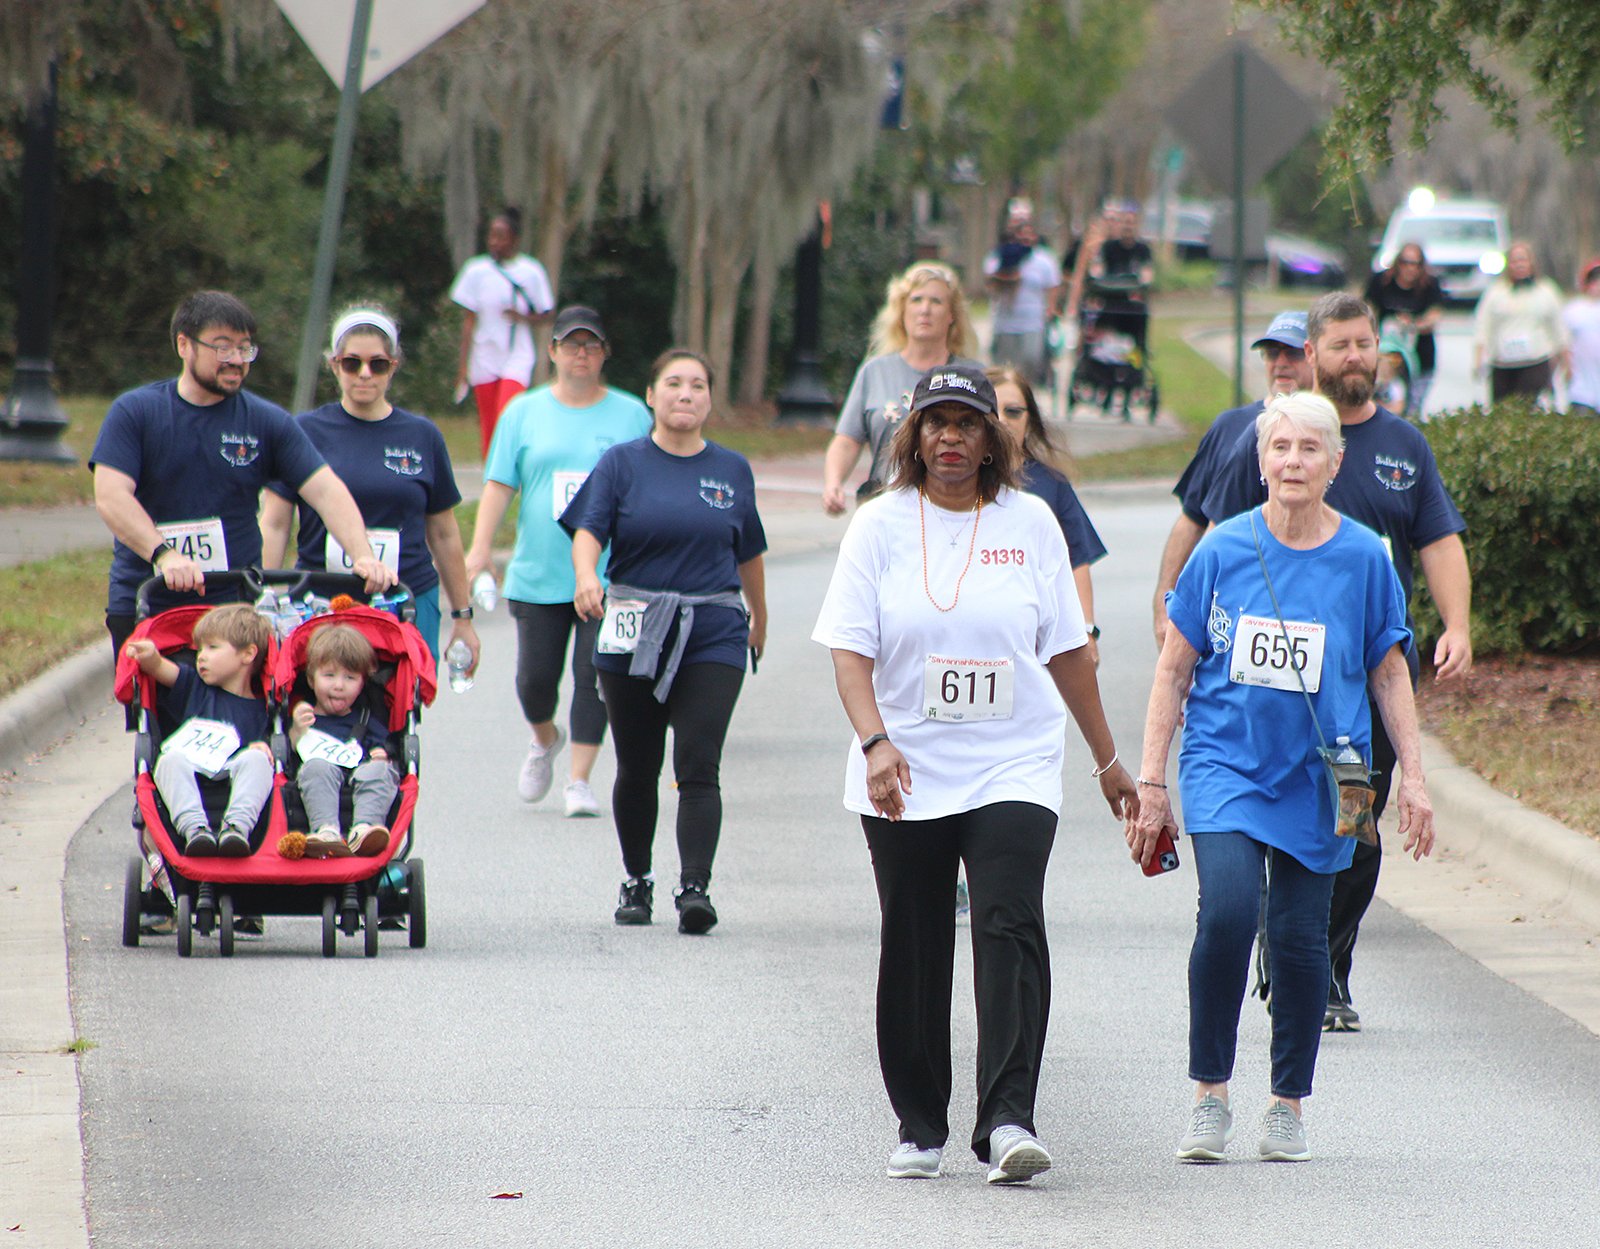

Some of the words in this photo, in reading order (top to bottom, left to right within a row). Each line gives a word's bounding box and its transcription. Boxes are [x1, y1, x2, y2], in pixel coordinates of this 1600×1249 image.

[980, 548, 1024, 566] 31313
[931, 655, 1009, 668] SavannahRaces.com
[1249, 632, 1309, 672] 655
[941, 669, 996, 704] 611
[182, 729, 226, 755] 744
[310, 736, 351, 764] 746
